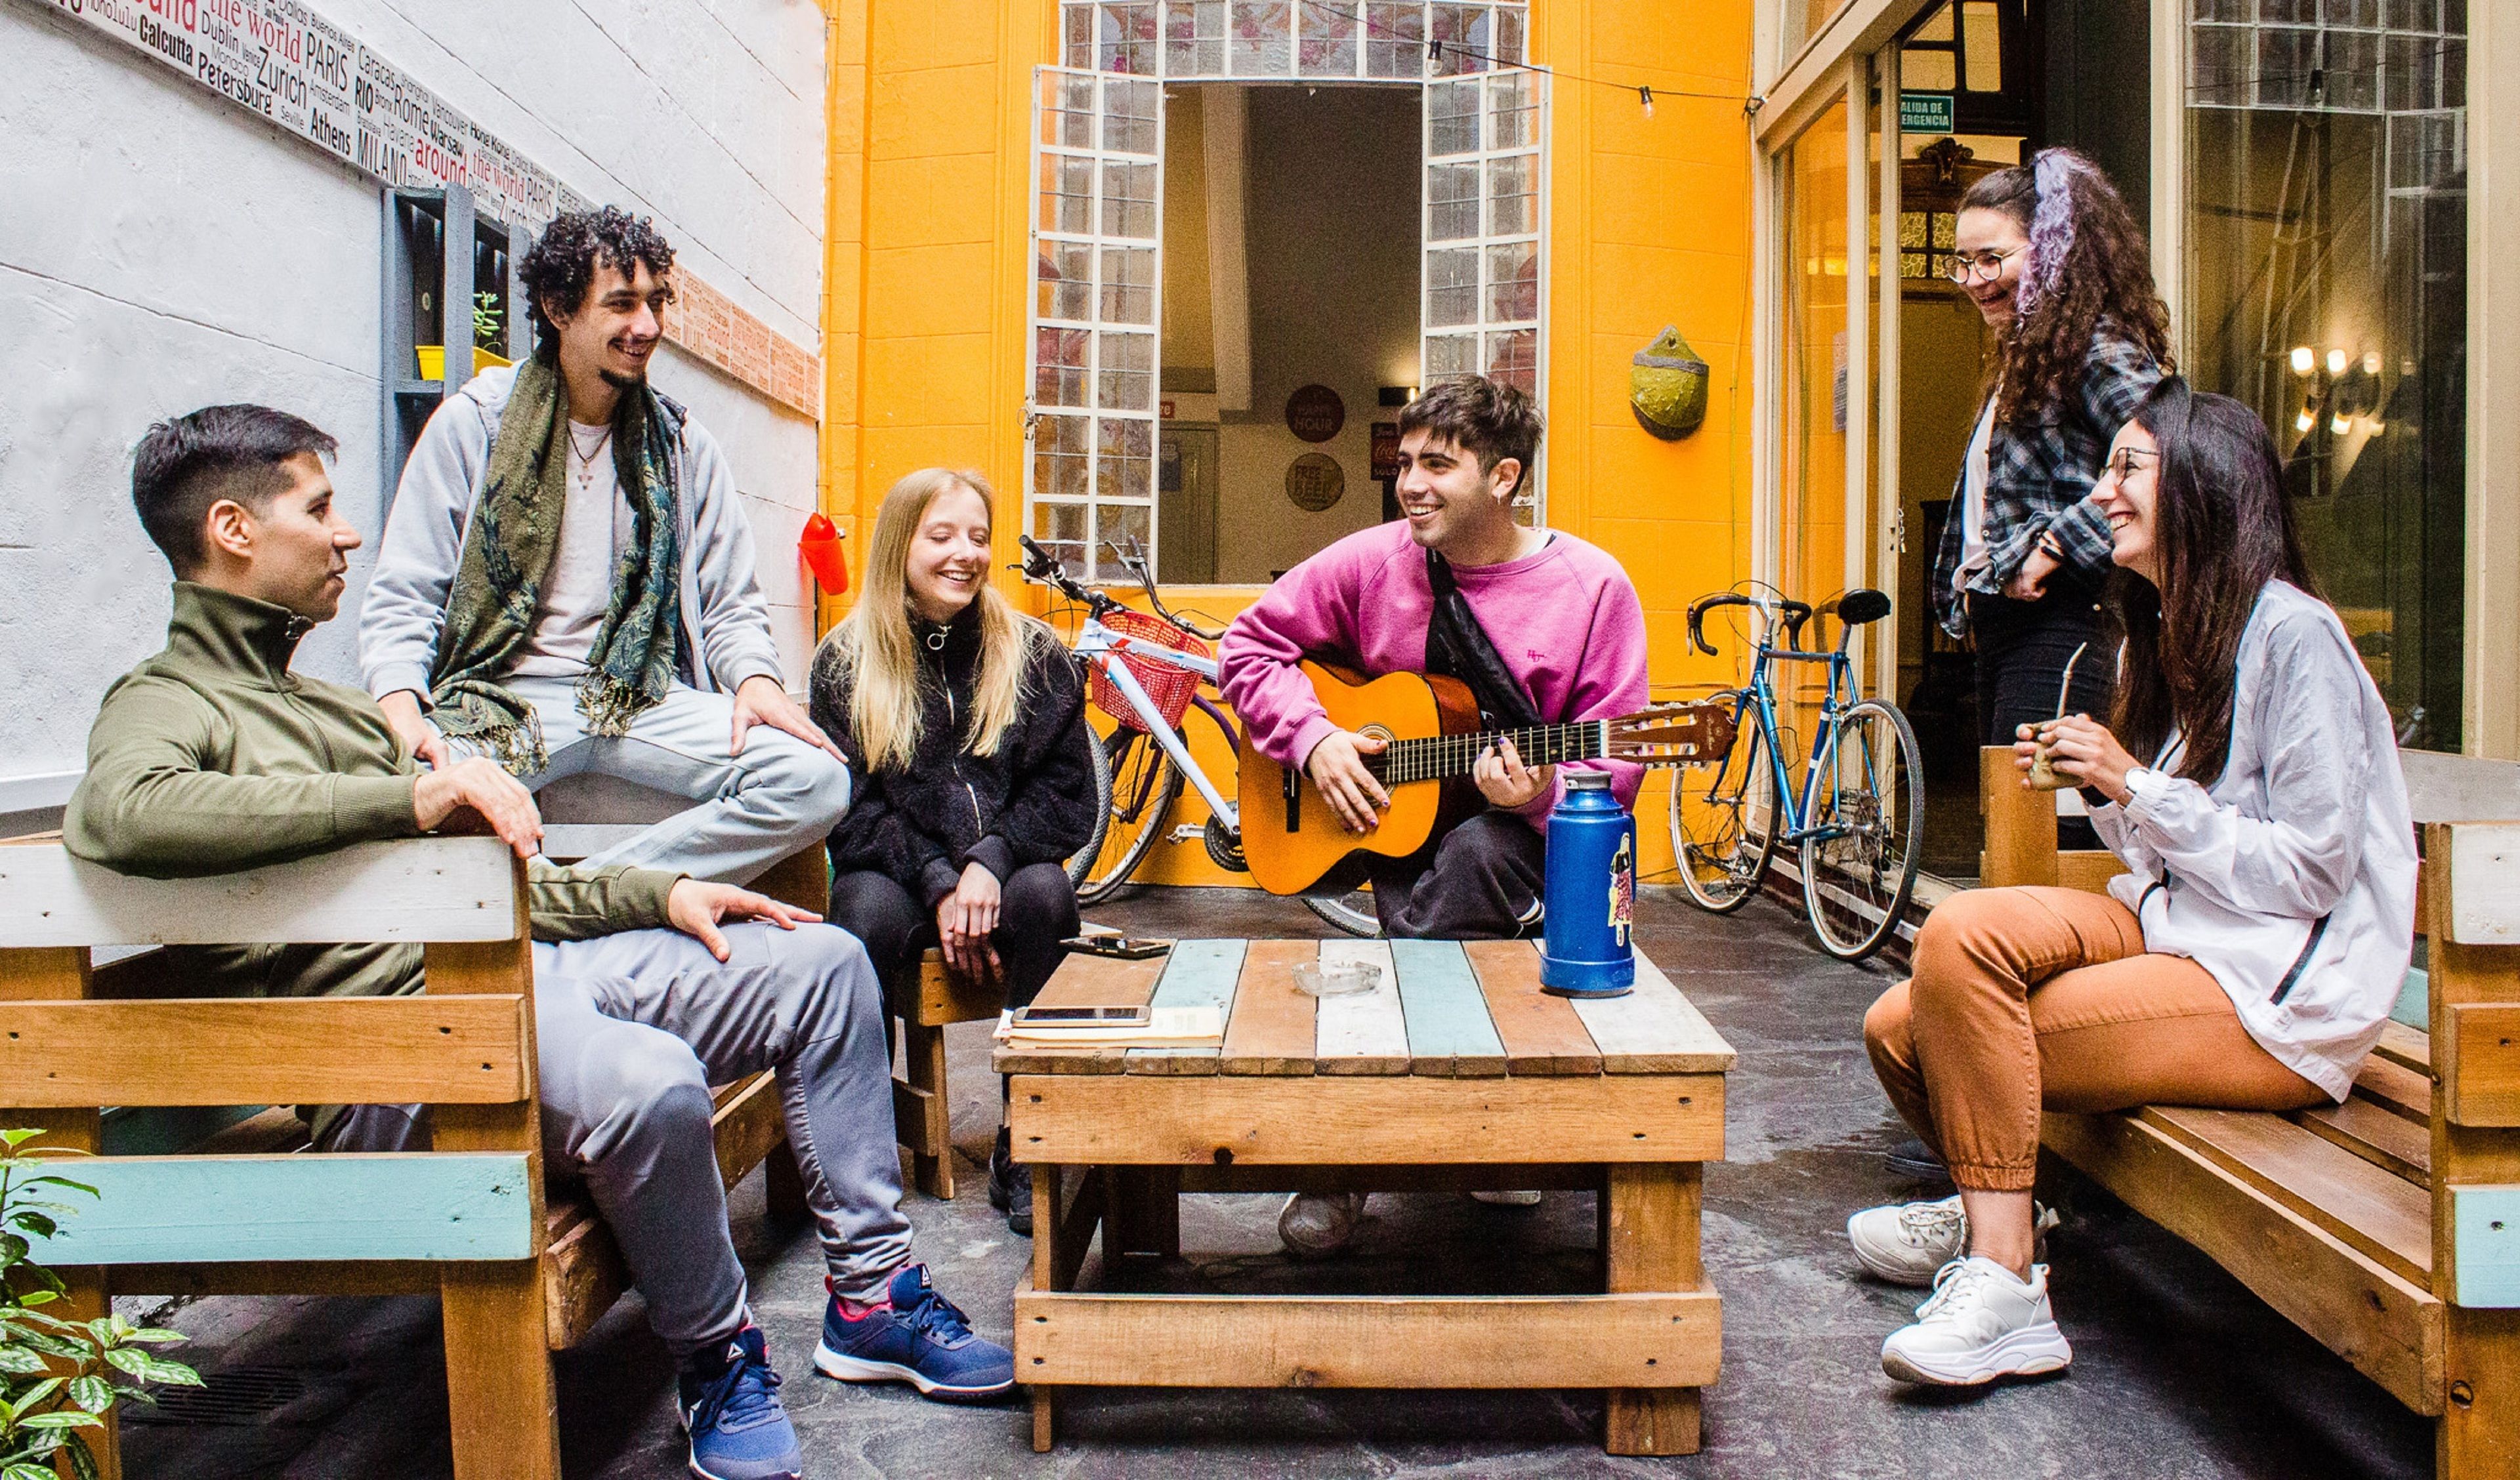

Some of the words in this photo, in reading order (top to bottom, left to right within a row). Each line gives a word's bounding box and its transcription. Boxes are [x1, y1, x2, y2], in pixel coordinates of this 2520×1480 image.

[140, 14, 194, 67] Calcutta
[201, 10, 239, 54] Dublin
[247, 9, 301, 64] world
[311, 12, 337, 41] Buenos
[338, 32, 356, 54] Aires
[211, 44, 249, 77] Monaco
[257, 46, 307, 110] Zurich
[306, 31, 348, 92] PARIS
[359, 45, 395, 91] Caracas
[198, 52, 272, 116] Petersburg
[310, 79, 350, 116] Amsterdam
[355, 75, 374, 114] RIO
[375, 88, 393, 114] Bronx
[280, 105, 304, 130] Seville
[394, 84, 429, 136] Rome
[432, 94, 468, 136] Vancouver
[1930, 102, 1942, 114] DE
[310, 108, 350, 156] Athens
[383, 113, 414, 154] Havana
[471, 121, 490, 147] Hong
[492, 135, 510, 160] Kong
[358, 128, 406, 188] MILANO
[415, 138, 467, 188] around
[472, 148, 490, 182] the
[494, 167, 525, 204] world
[526, 176, 552, 220] PARIS
[1295, 417, 1334, 432] HOUR
[1295, 464, 1321, 479] FREE
